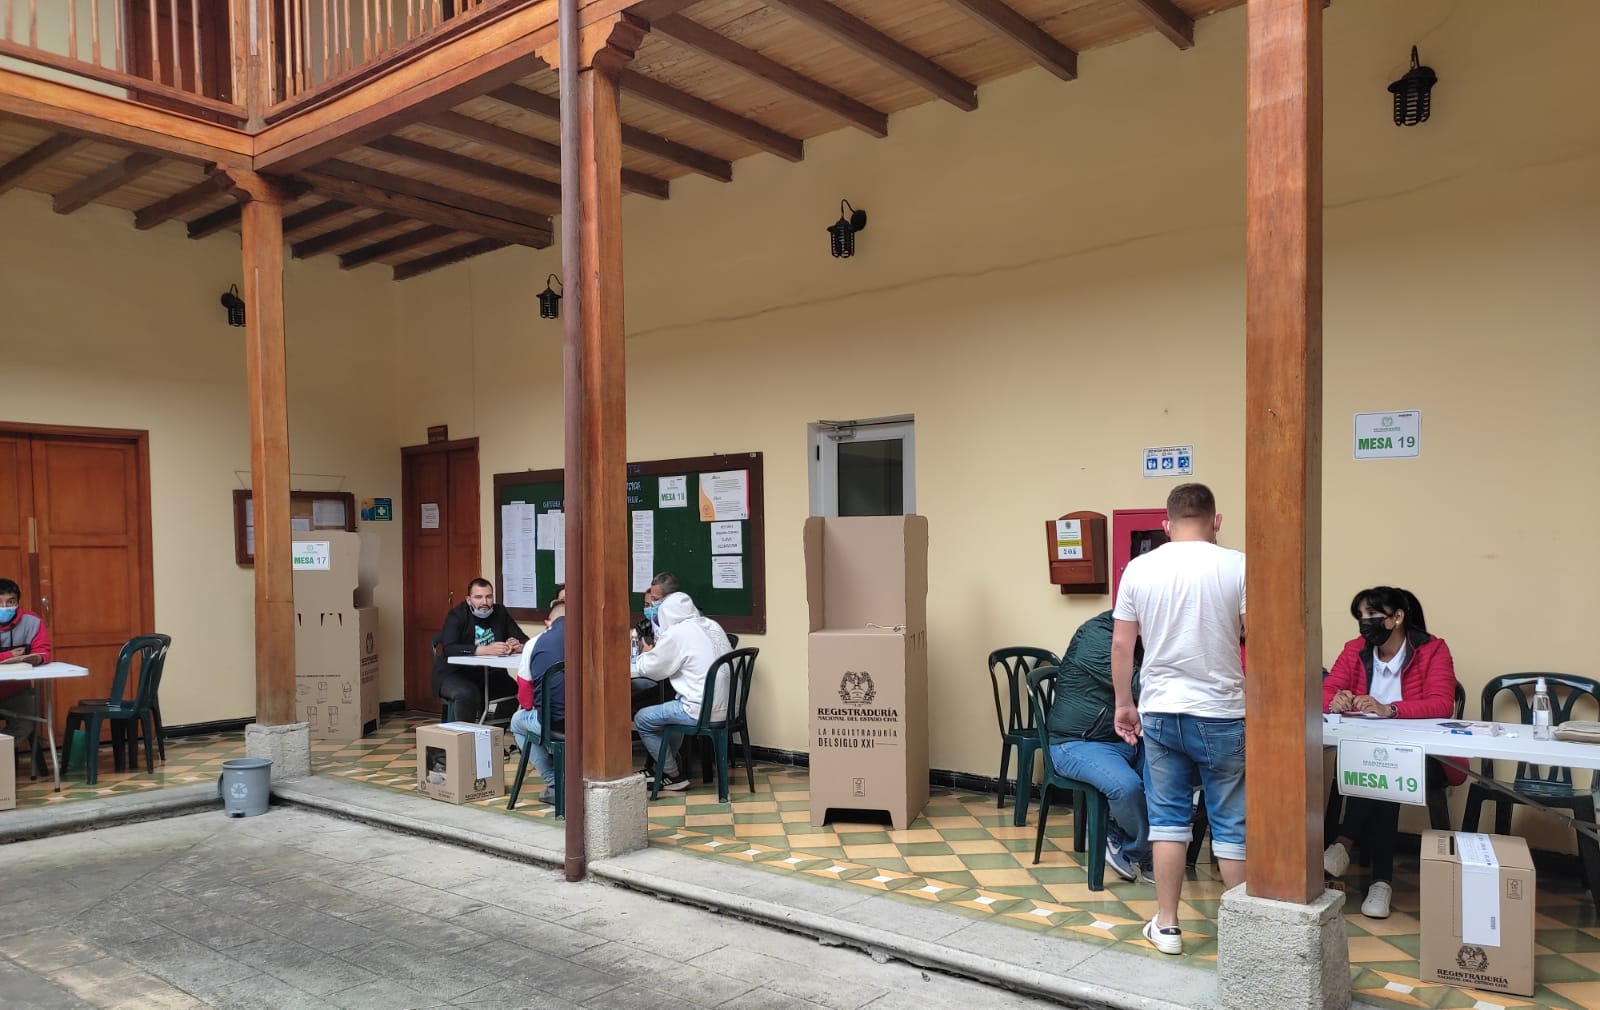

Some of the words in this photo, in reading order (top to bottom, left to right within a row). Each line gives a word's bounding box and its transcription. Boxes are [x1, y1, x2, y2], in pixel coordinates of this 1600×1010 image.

[1358, 437, 1393, 450] MESA
[1397, 436, 1416, 448] 19
[661, 492, 676, 501] MESA
[294, 556, 314, 565] MESA
[317, 556, 327, 565] 17
[817, 706, 898, 717] REGISTRADURÍA
[818, 728, 827, 736] LA
[818, 737, 833, 747] DEL
[834, 737, 858, 748] SIGLO
[861, 738, 875, 748] XXI
[1344, 771, 1389, 790] MESA
[1395, 776, 1418, 792] 19
